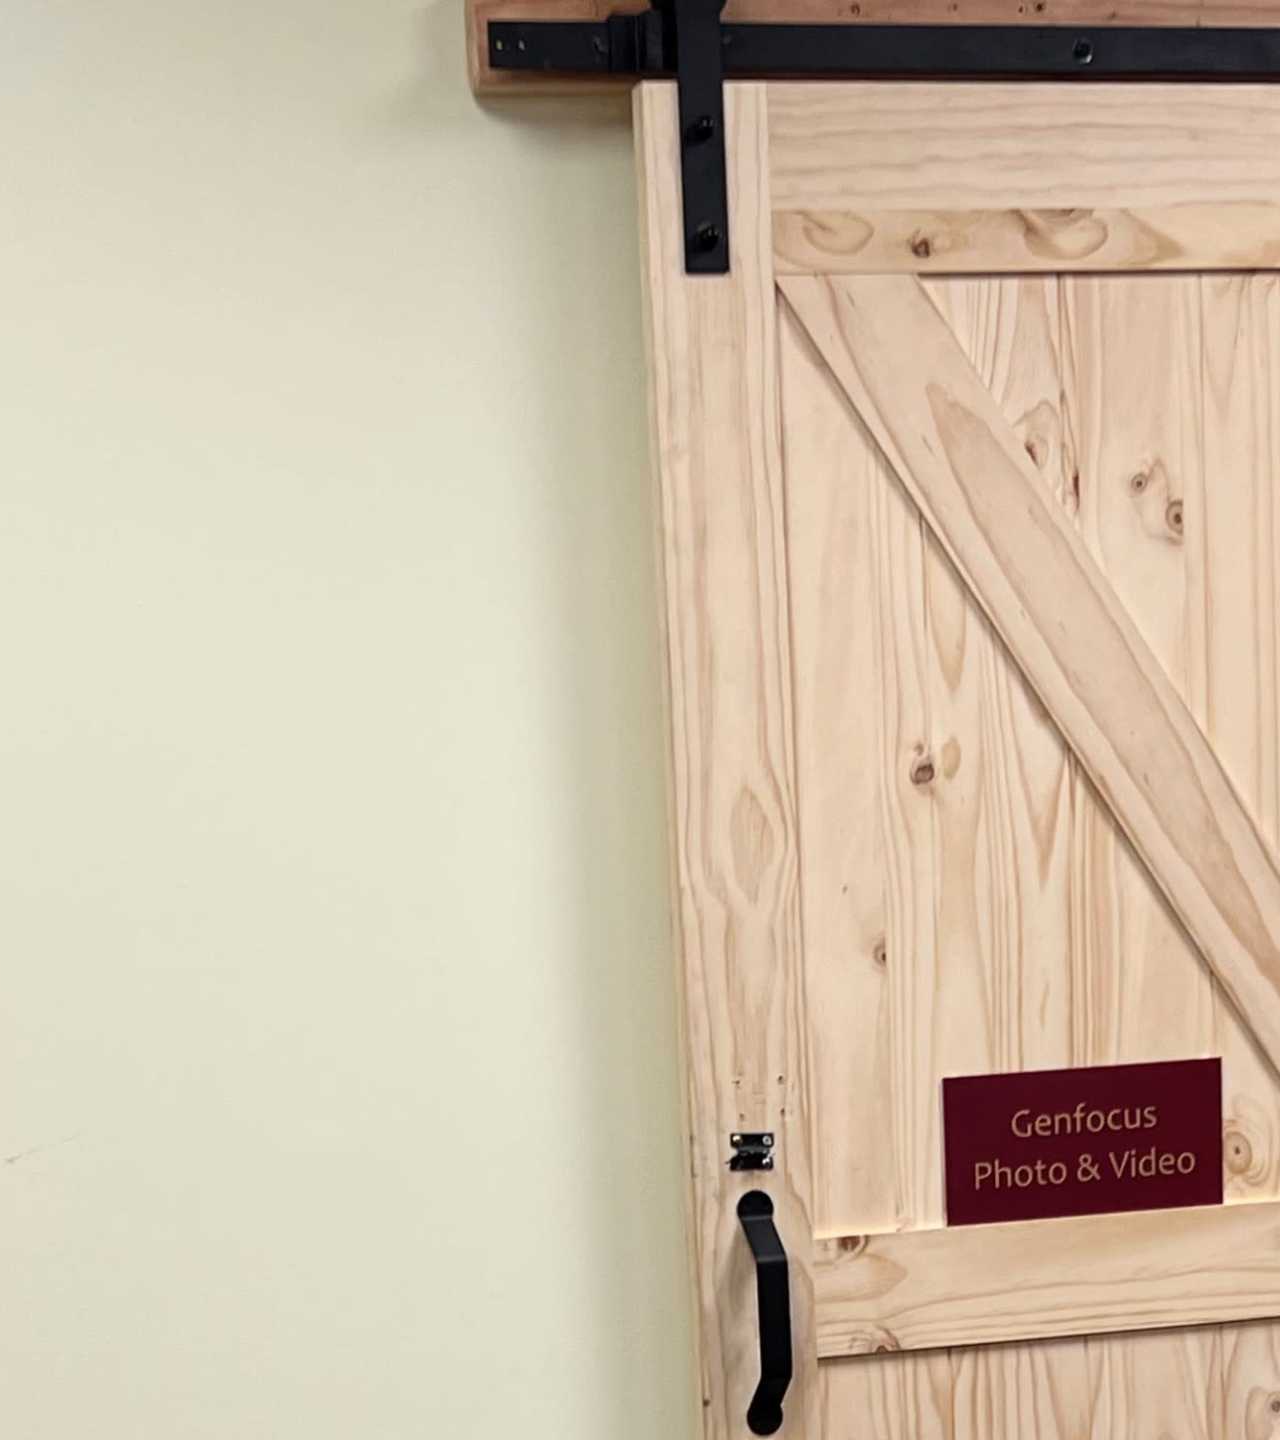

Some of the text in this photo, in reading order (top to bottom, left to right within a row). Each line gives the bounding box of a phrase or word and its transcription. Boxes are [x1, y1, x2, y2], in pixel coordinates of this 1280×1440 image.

[1011, 1102, 1157, 1138] Genfocus
[974, 1146, 1196, 1190] Photo & Video
